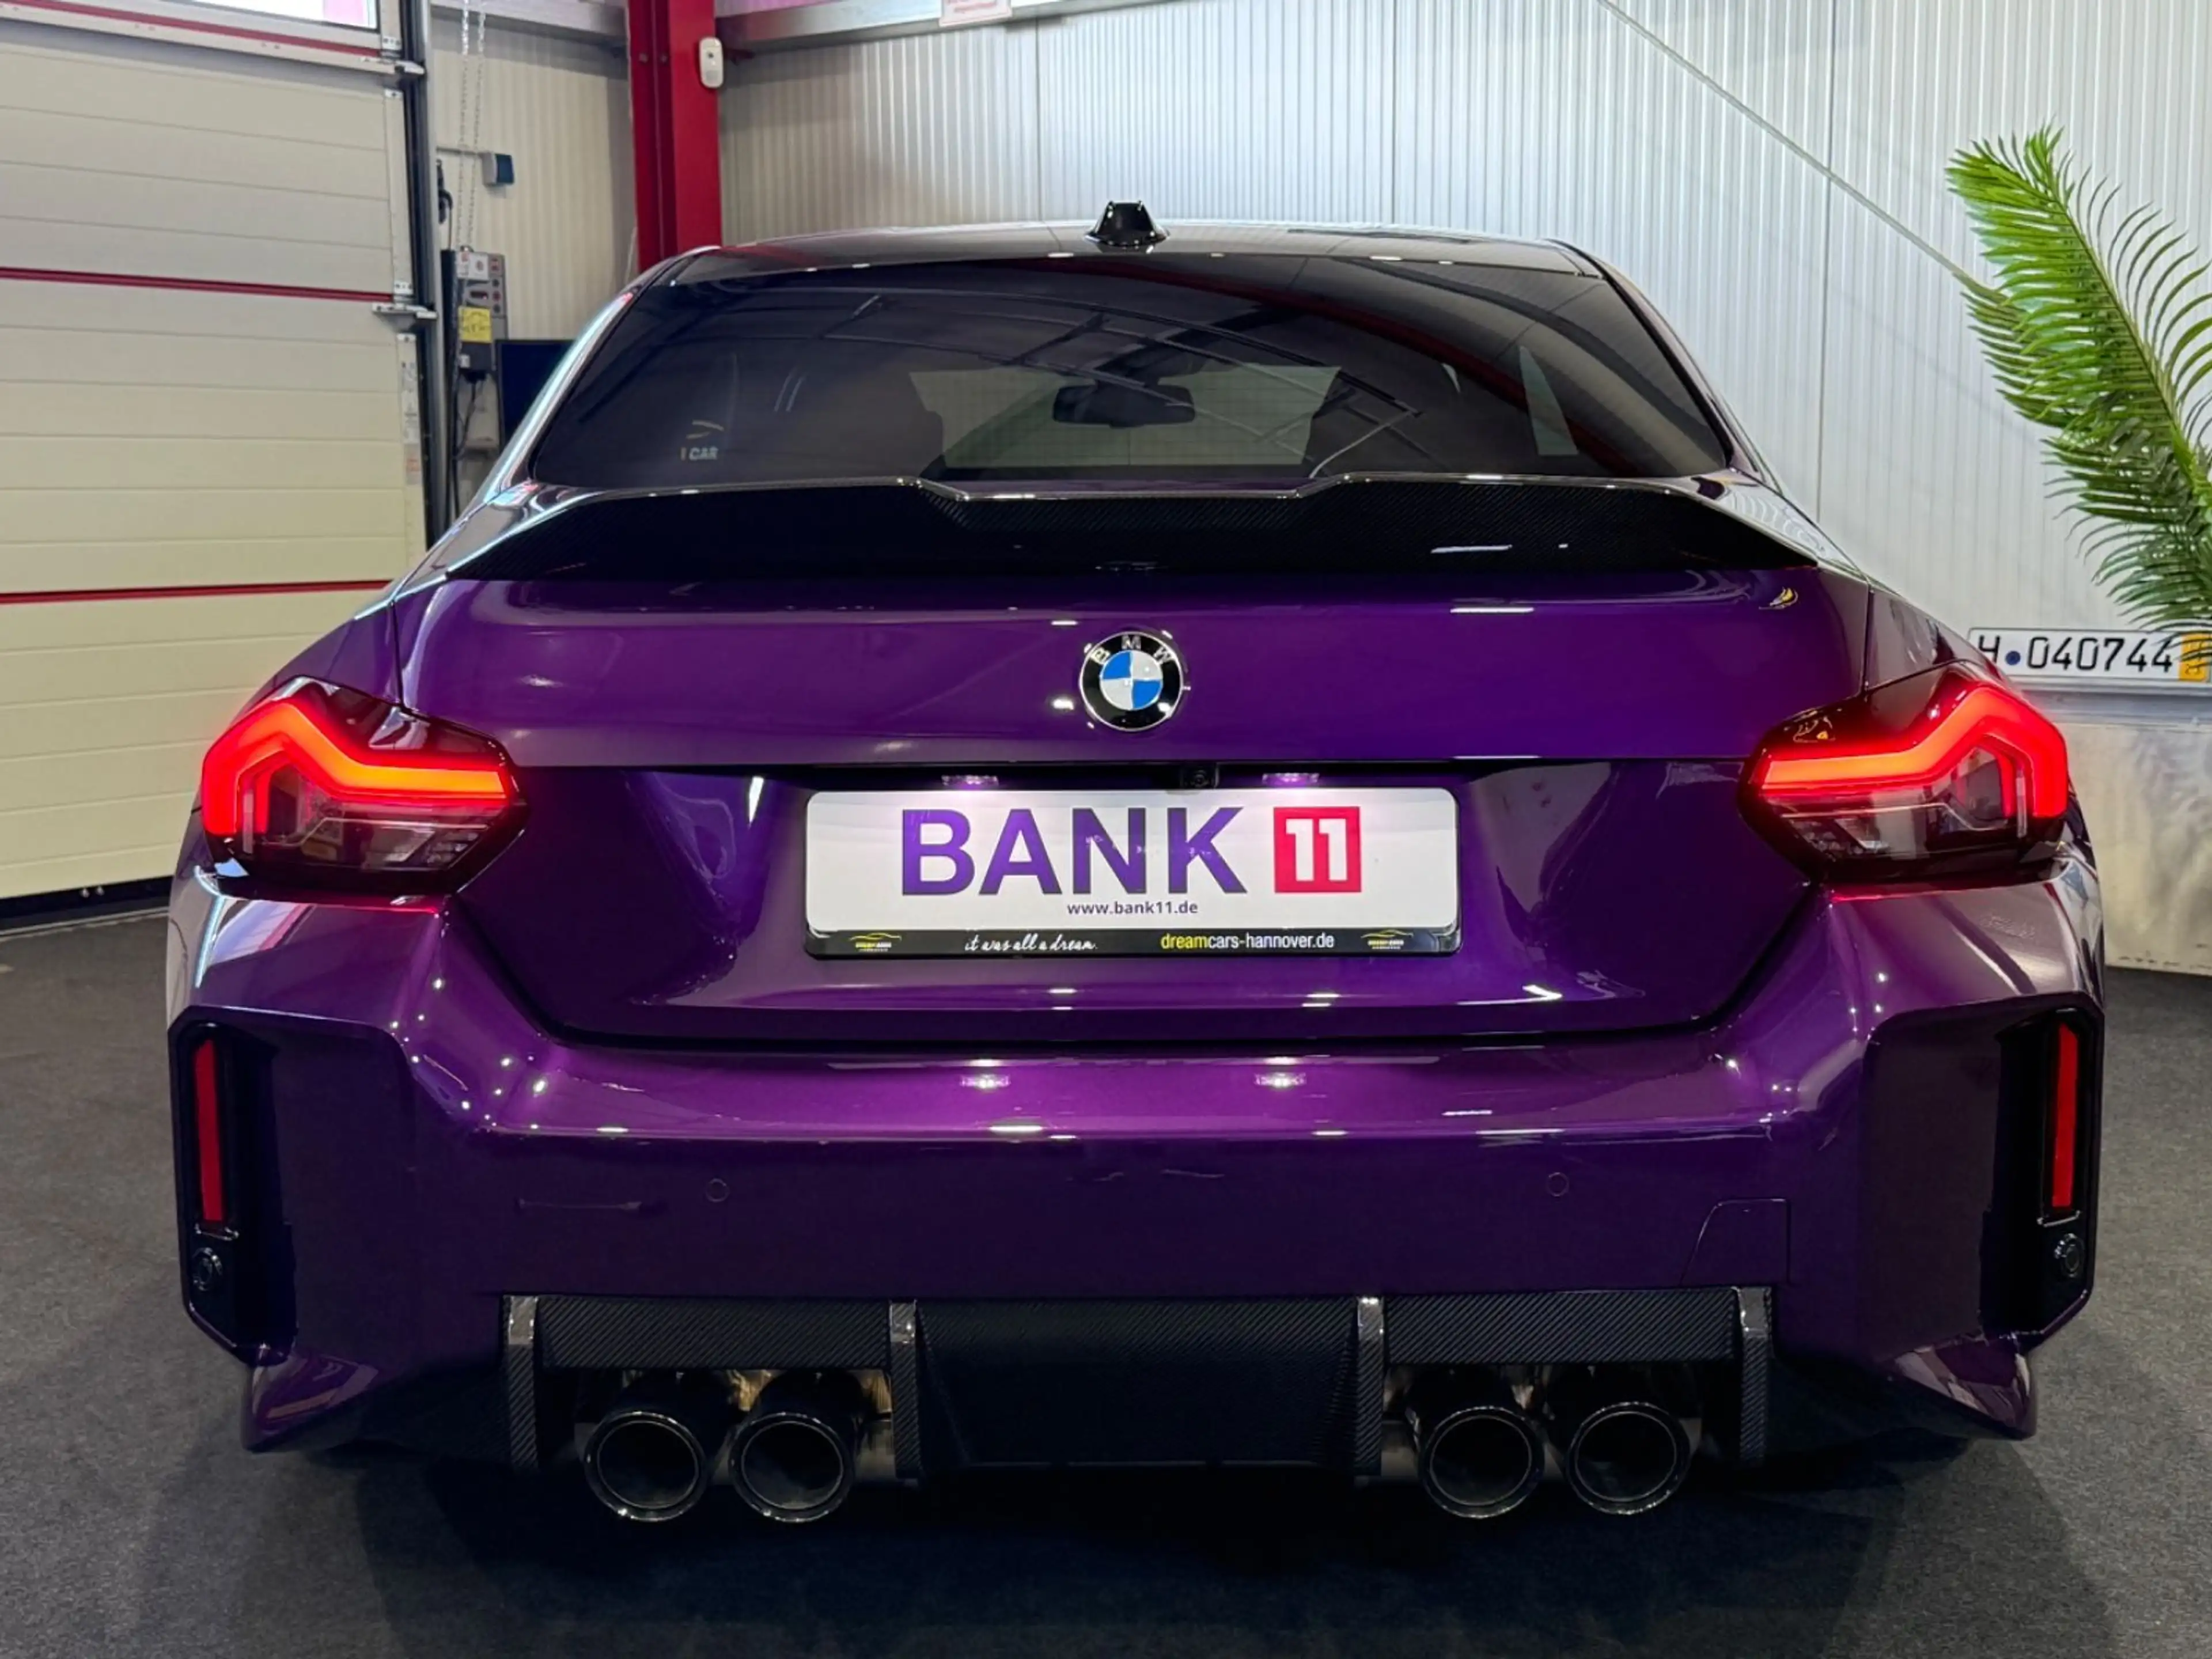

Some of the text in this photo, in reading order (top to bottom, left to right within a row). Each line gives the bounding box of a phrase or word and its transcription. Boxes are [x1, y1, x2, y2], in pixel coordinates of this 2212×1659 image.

[1090, 635, 1174, 665] BMW
[2027, 636, 2173, 673] 040744
[902, 807, 1348, 896] BANK 11
[1067, 900, 1199, 915] www.bank11.de
[964, 933, 979, 950] it
[980, 940, 1010, 951] was
[1012, 933, 1039, 950] all
[1038, 940, 1048, 950] a
[1160, 932, 1335, 949] dreamcars-hannover.de
